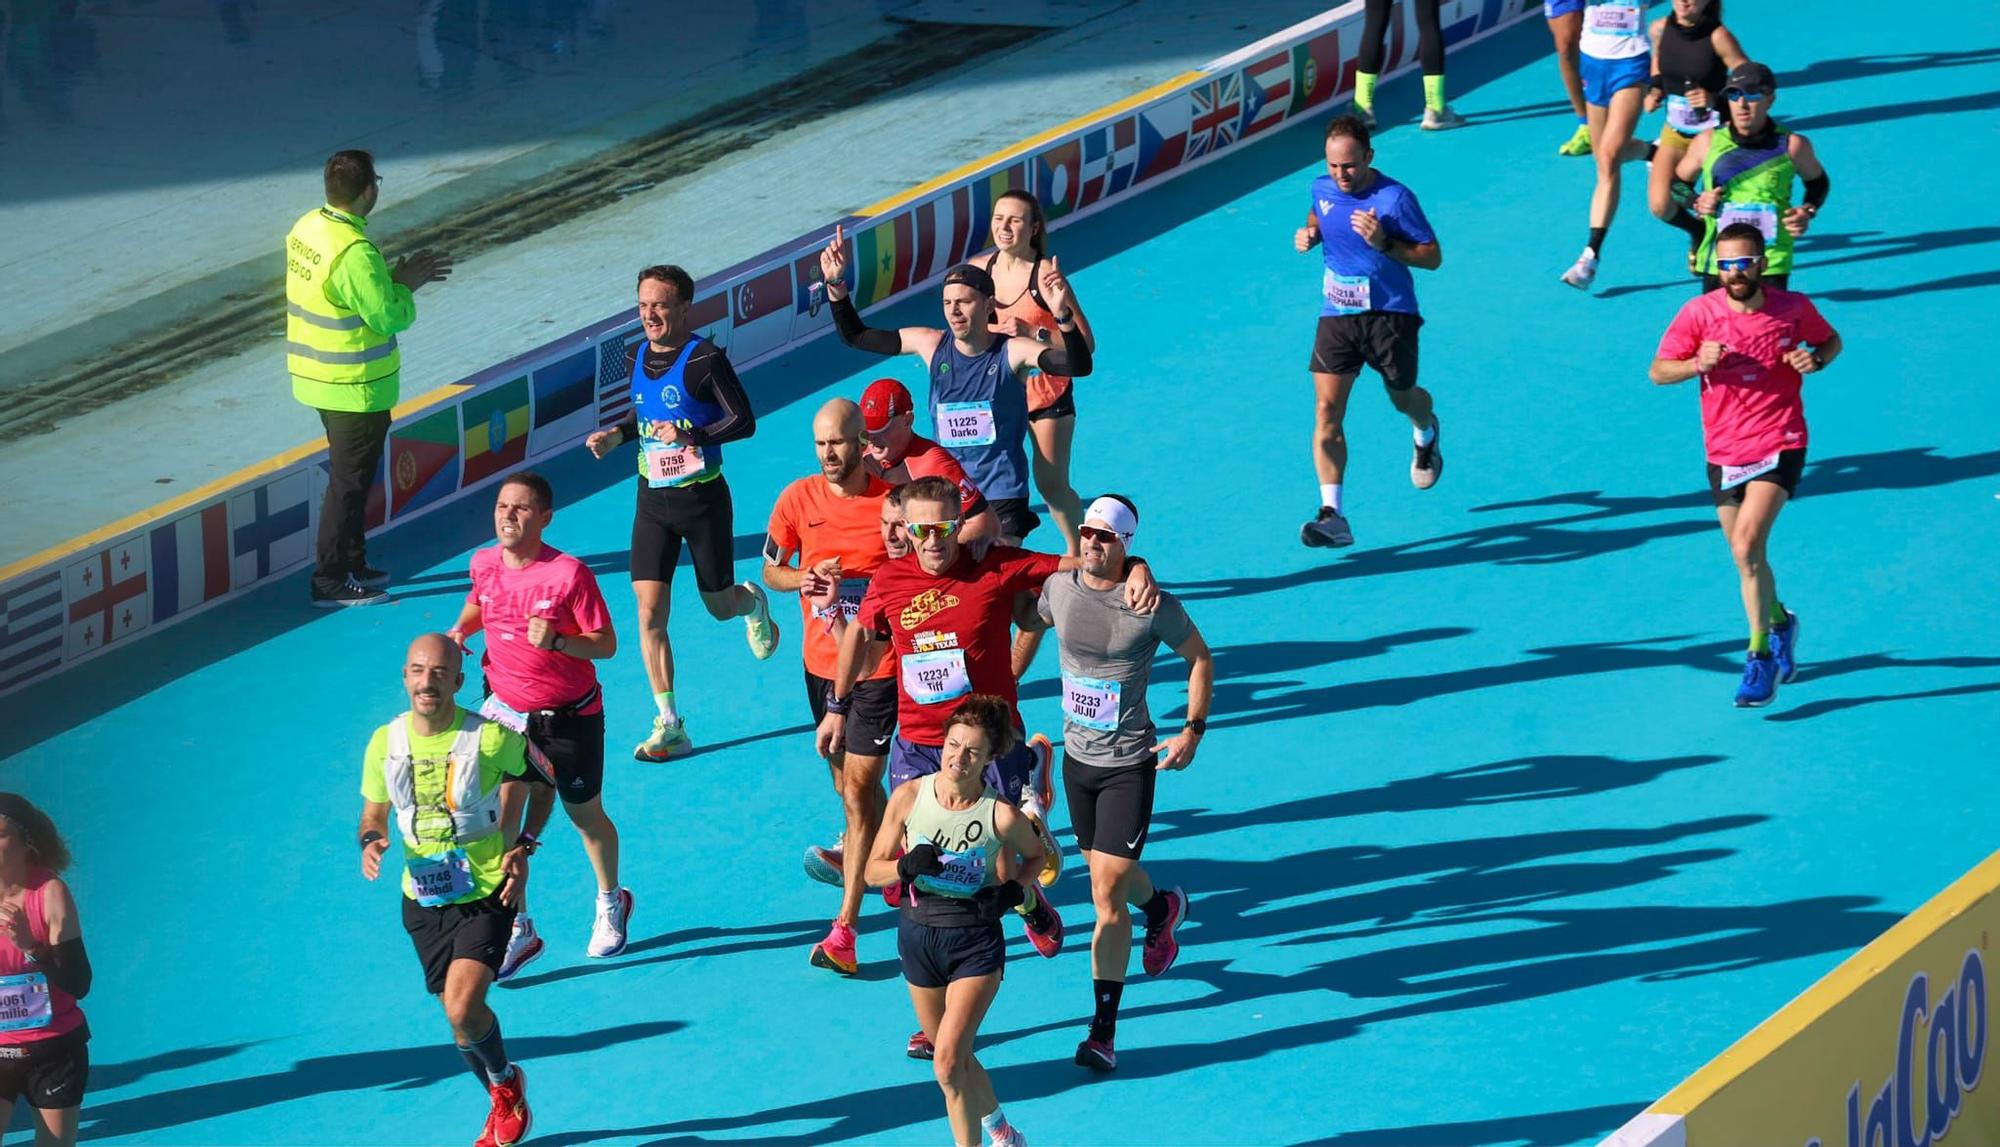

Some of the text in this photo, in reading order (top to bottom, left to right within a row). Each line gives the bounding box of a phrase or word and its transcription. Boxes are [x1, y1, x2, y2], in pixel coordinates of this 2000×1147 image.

[948, 416, 977, 427] 11225
[951, 427, 978, 438] Darko
[660, 455, 685, 467] 6758
[840, 595, 861, 605] 249
[935, 638, 959, 650] TEXAS
[918, 667, 949, 682] 12234
[927, 681, 944, 692] Tiff
[1071, 691, 1101, 707] 12233
[1072, 704, 1096, 718] JUJU
[944, 863, 966, 875] 002
[415, 870, 452, 885] 11748
[418, 883, 453, 897] Mehdi
